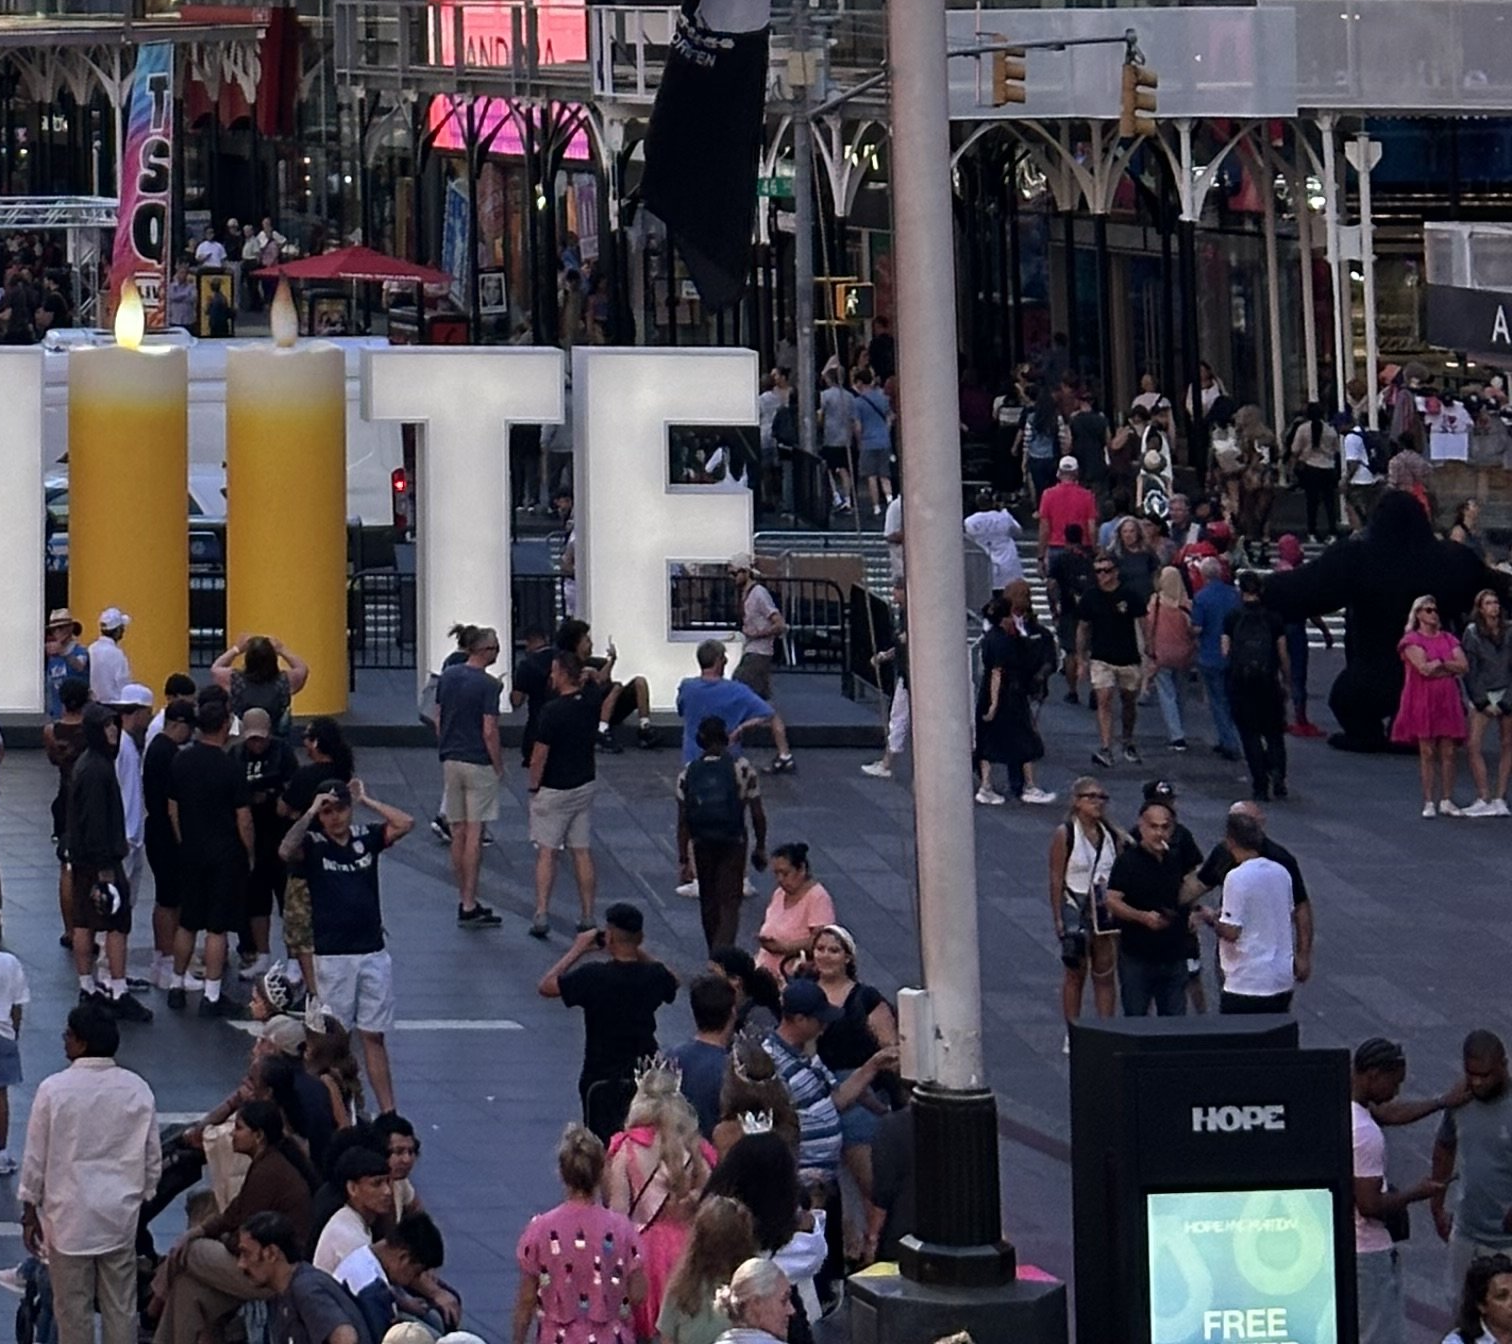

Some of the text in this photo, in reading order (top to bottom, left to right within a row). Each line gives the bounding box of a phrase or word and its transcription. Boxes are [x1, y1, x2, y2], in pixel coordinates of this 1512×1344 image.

[130, 72, 171, 268] TSQ
[1191, 1104, 1286, 1132] HOPE
[1203, 1307, 1288, 1341] FREE
